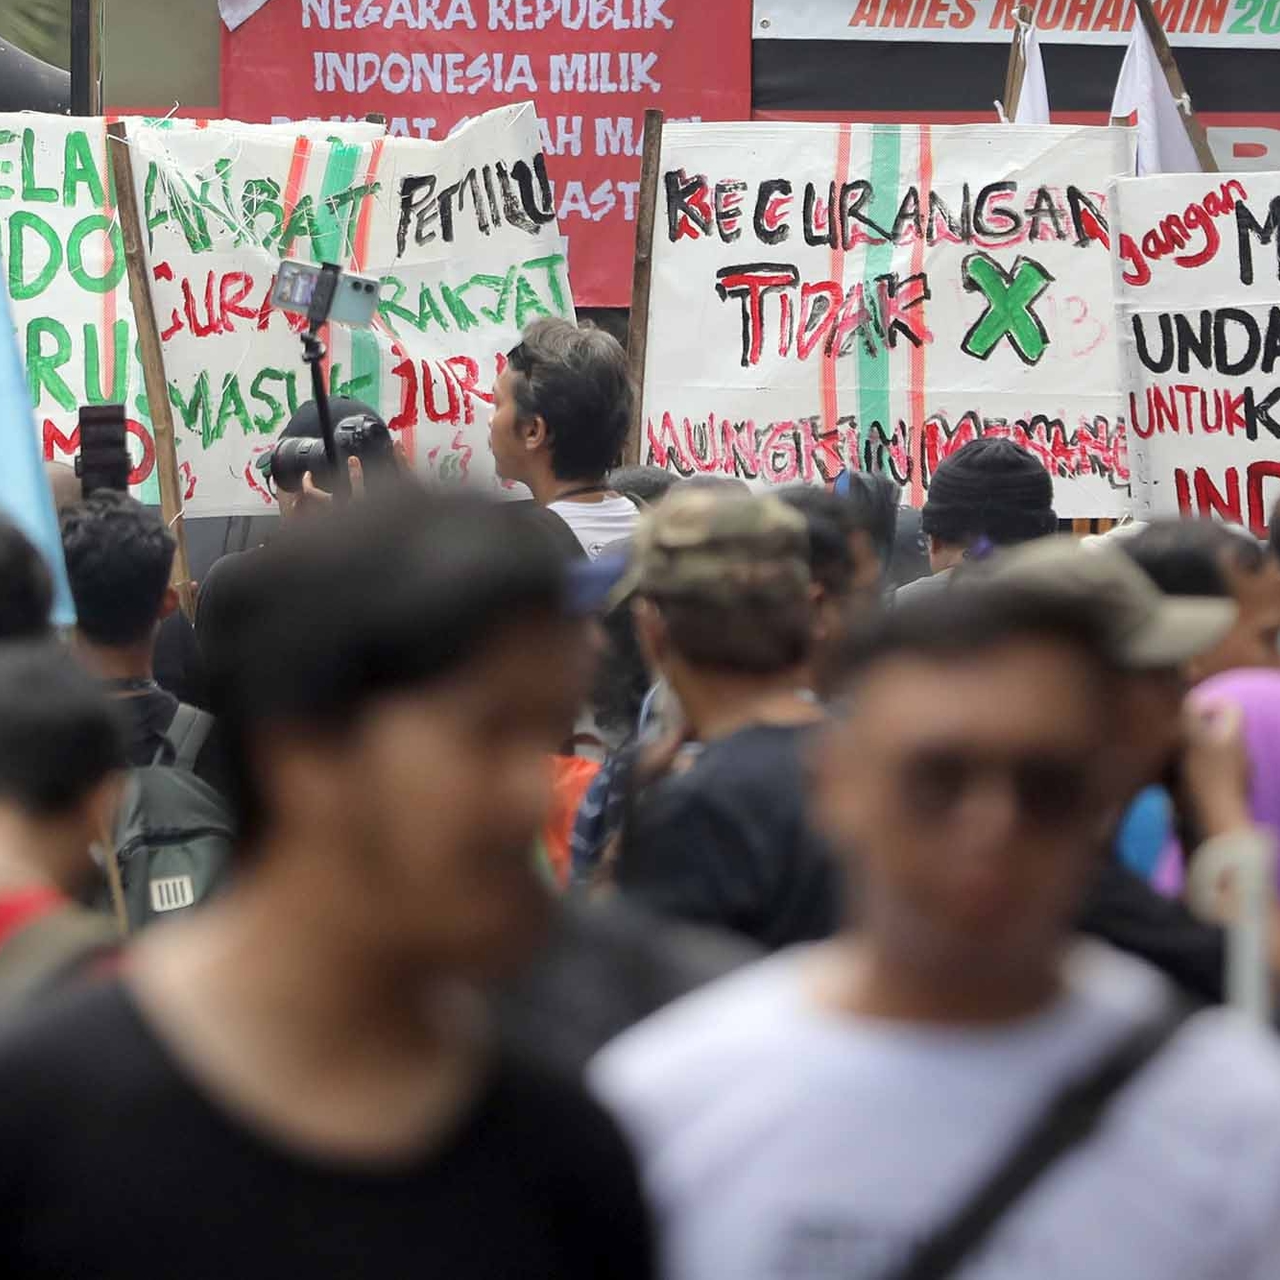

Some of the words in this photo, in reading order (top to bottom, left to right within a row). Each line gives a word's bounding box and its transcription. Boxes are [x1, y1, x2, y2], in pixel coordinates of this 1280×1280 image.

[313, 51, 539, 93] INDONESIA
[549, 51, 662, 93] MILIK
[665, 169, 1110, 251] KECURANGAN
[716, 261, 933, 366] TIDAK
[1129, 382, 1247, 439] UNTUK
